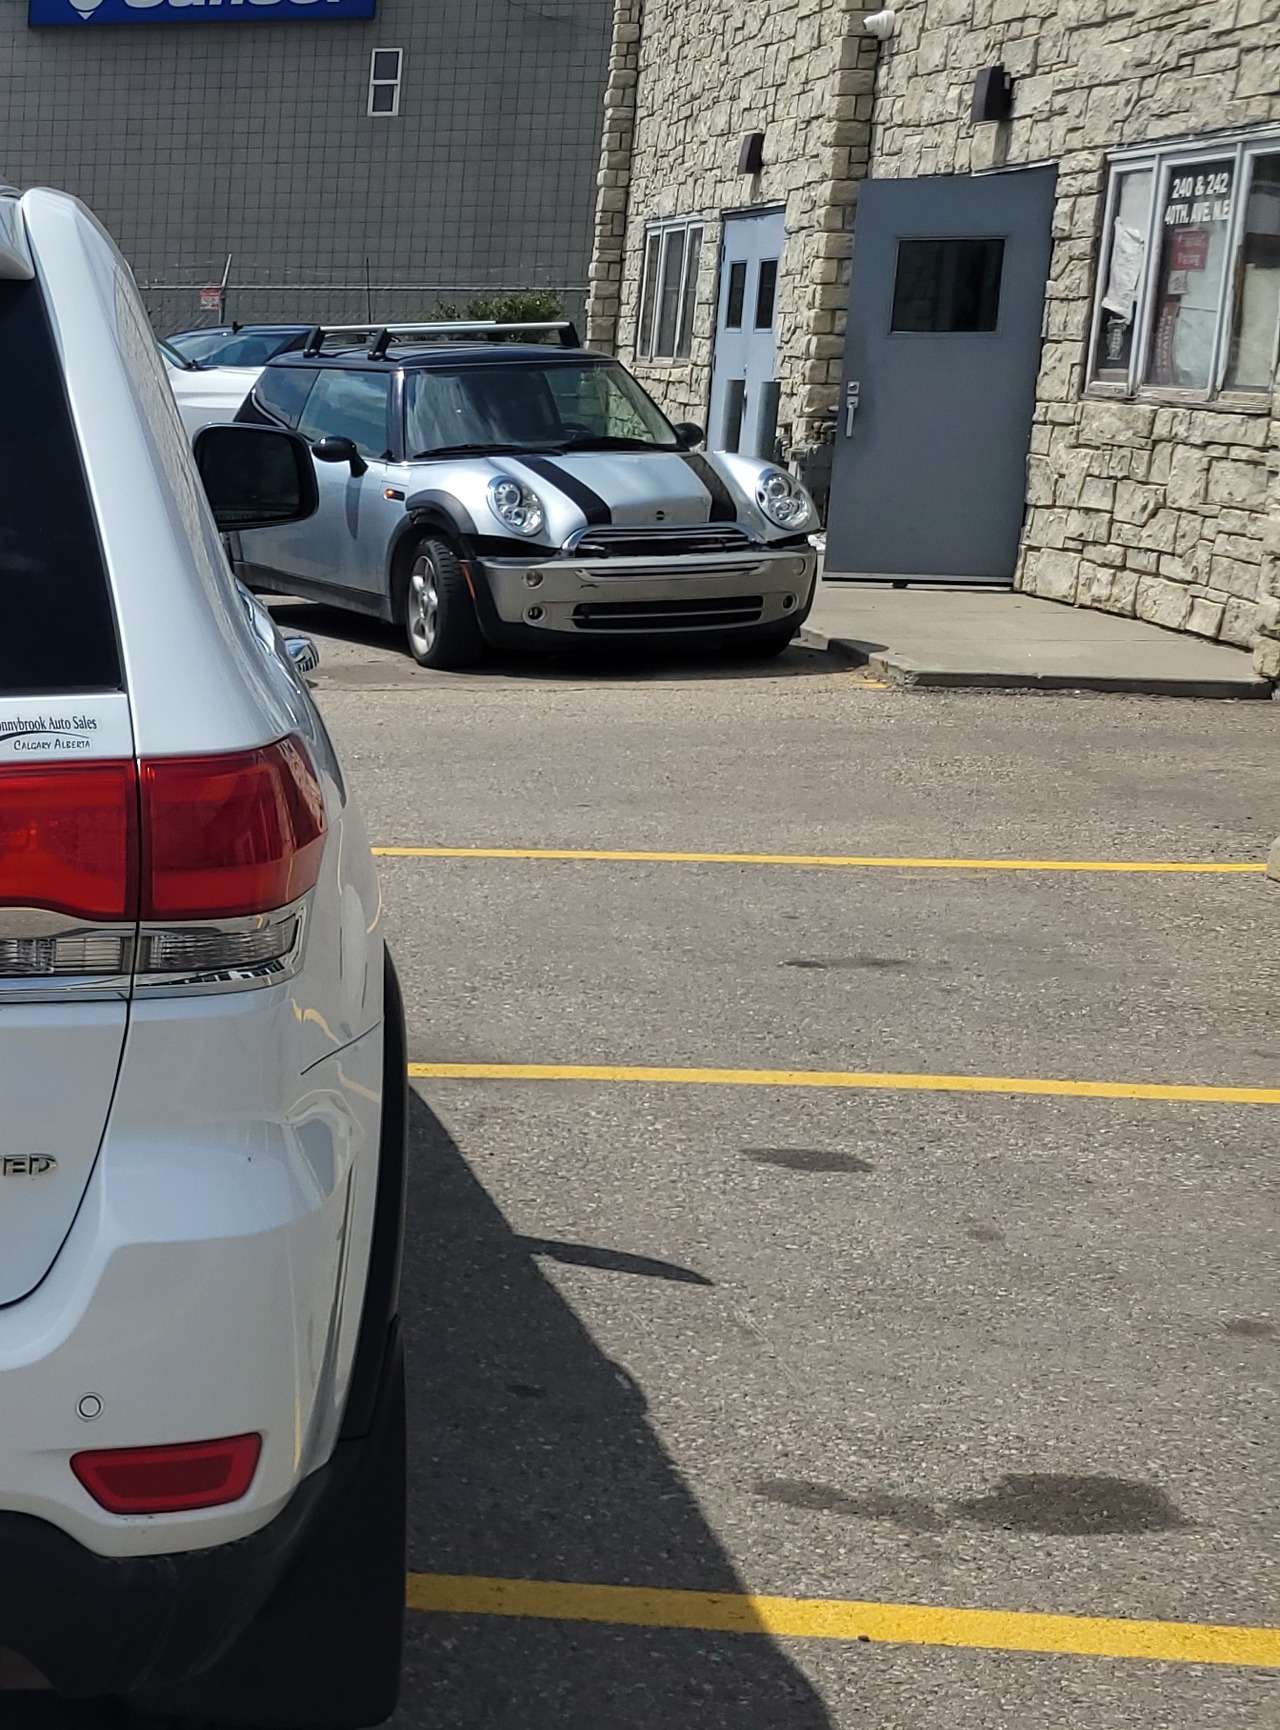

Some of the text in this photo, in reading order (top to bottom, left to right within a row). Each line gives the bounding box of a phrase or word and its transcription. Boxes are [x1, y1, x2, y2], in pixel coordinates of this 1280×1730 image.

[1171, 173, 1229, 199] 240 & 242
[48, 716, 72, 730] Auto
[73, 715, 97, 730] Sales
[13, 738, 91, 750] CALGARY ALBERTA
